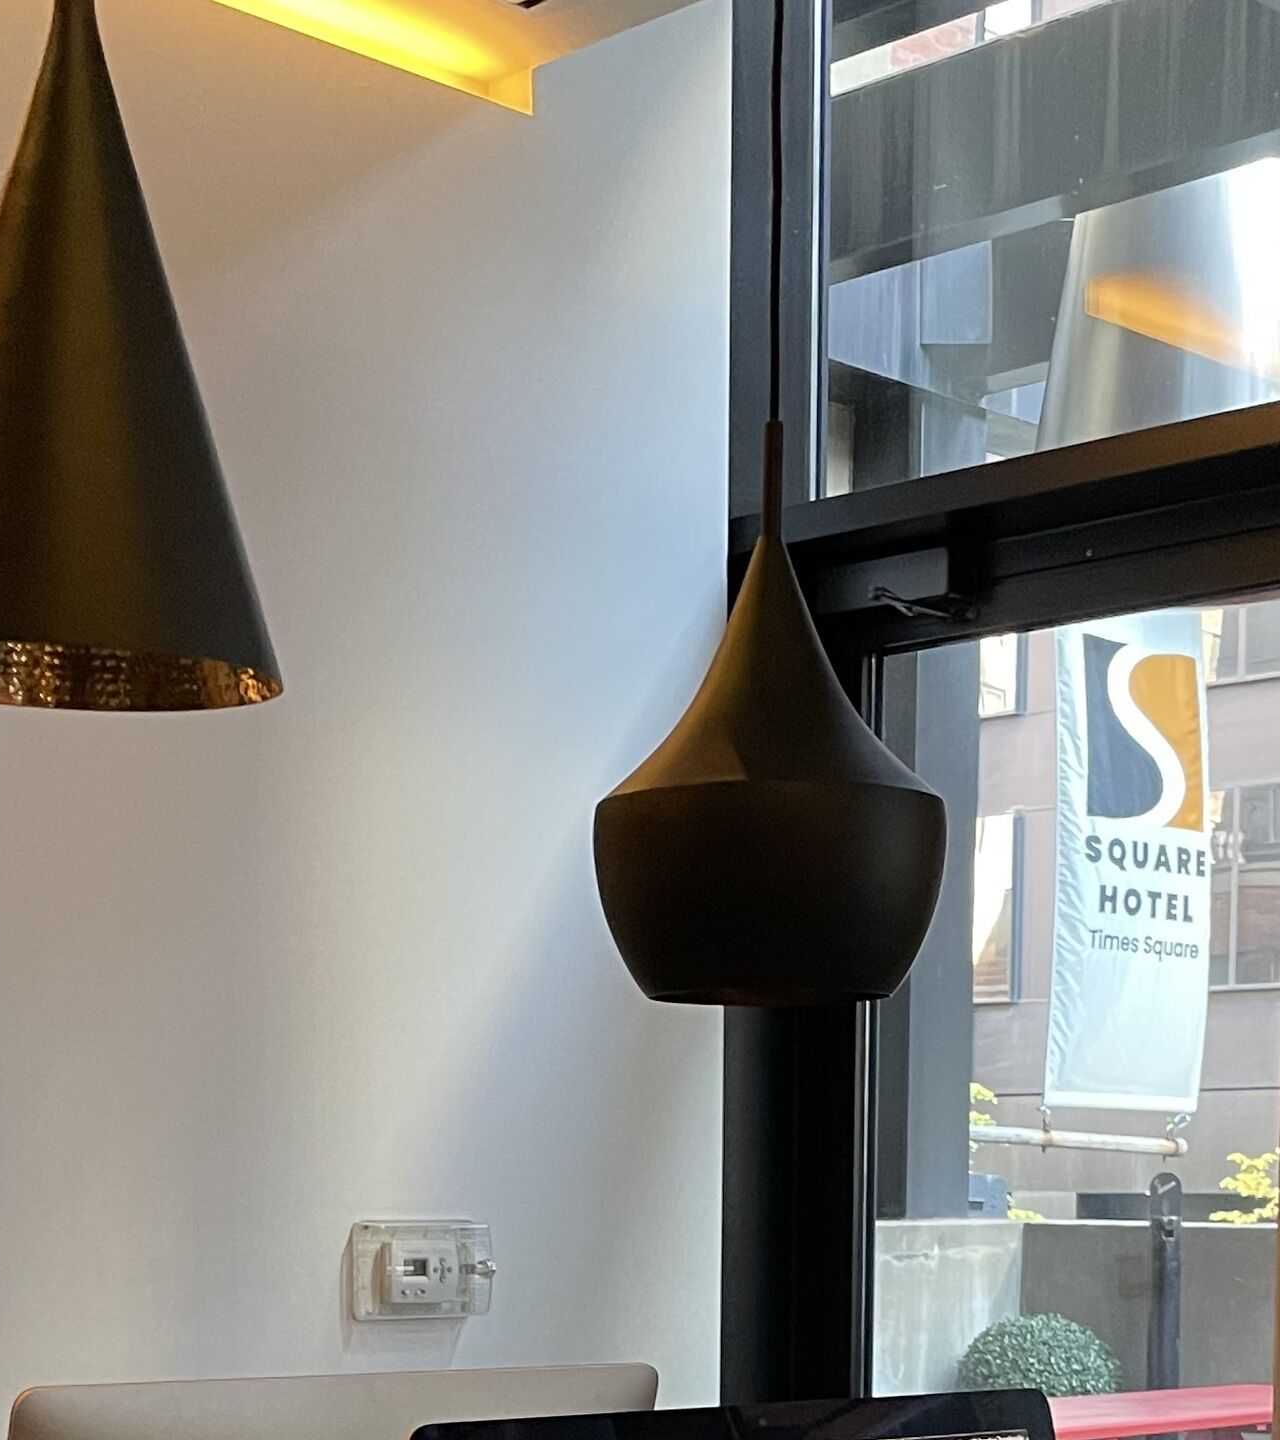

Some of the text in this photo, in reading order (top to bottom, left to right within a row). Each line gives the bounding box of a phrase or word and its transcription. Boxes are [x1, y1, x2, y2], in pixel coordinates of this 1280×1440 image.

[1084, 833, 1207, 878] SQUARE
[1098, 883, 1194, 923] HOTEL
[1089, 929, 1199, 962] Times Square
